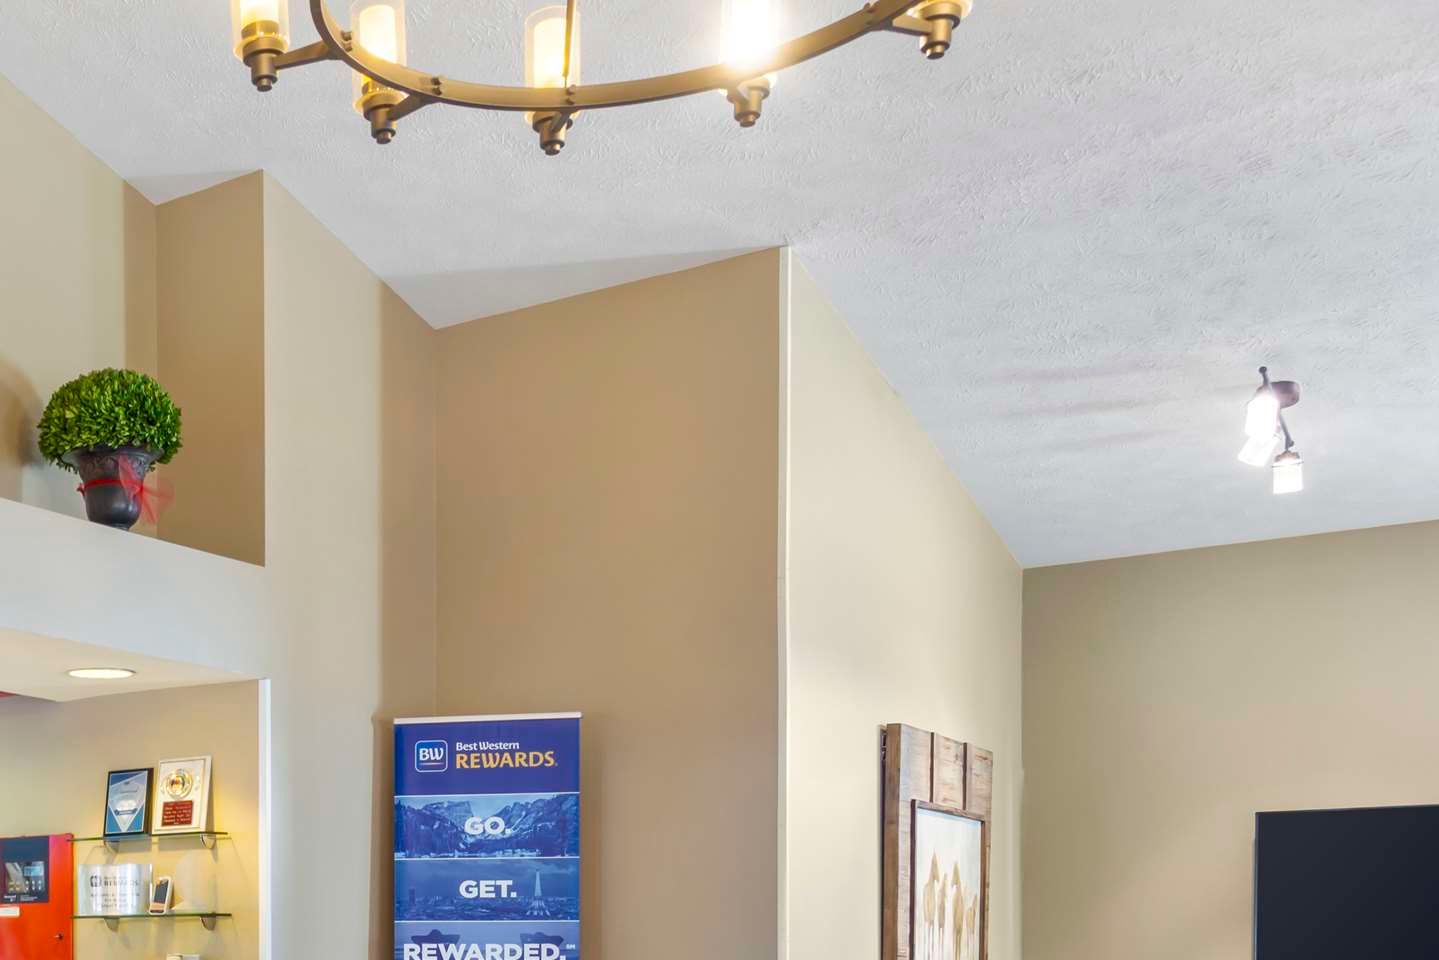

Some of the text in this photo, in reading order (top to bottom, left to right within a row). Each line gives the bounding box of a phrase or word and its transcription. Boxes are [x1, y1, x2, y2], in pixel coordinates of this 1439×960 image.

[419, 747, 443, 761] BW
[456, 741, 520, 751] Best Western
[464, 816, 511, 835] GO.
[459, 880, 517, 898] GET.
[403, 943, 566, 960] REWARDED.
